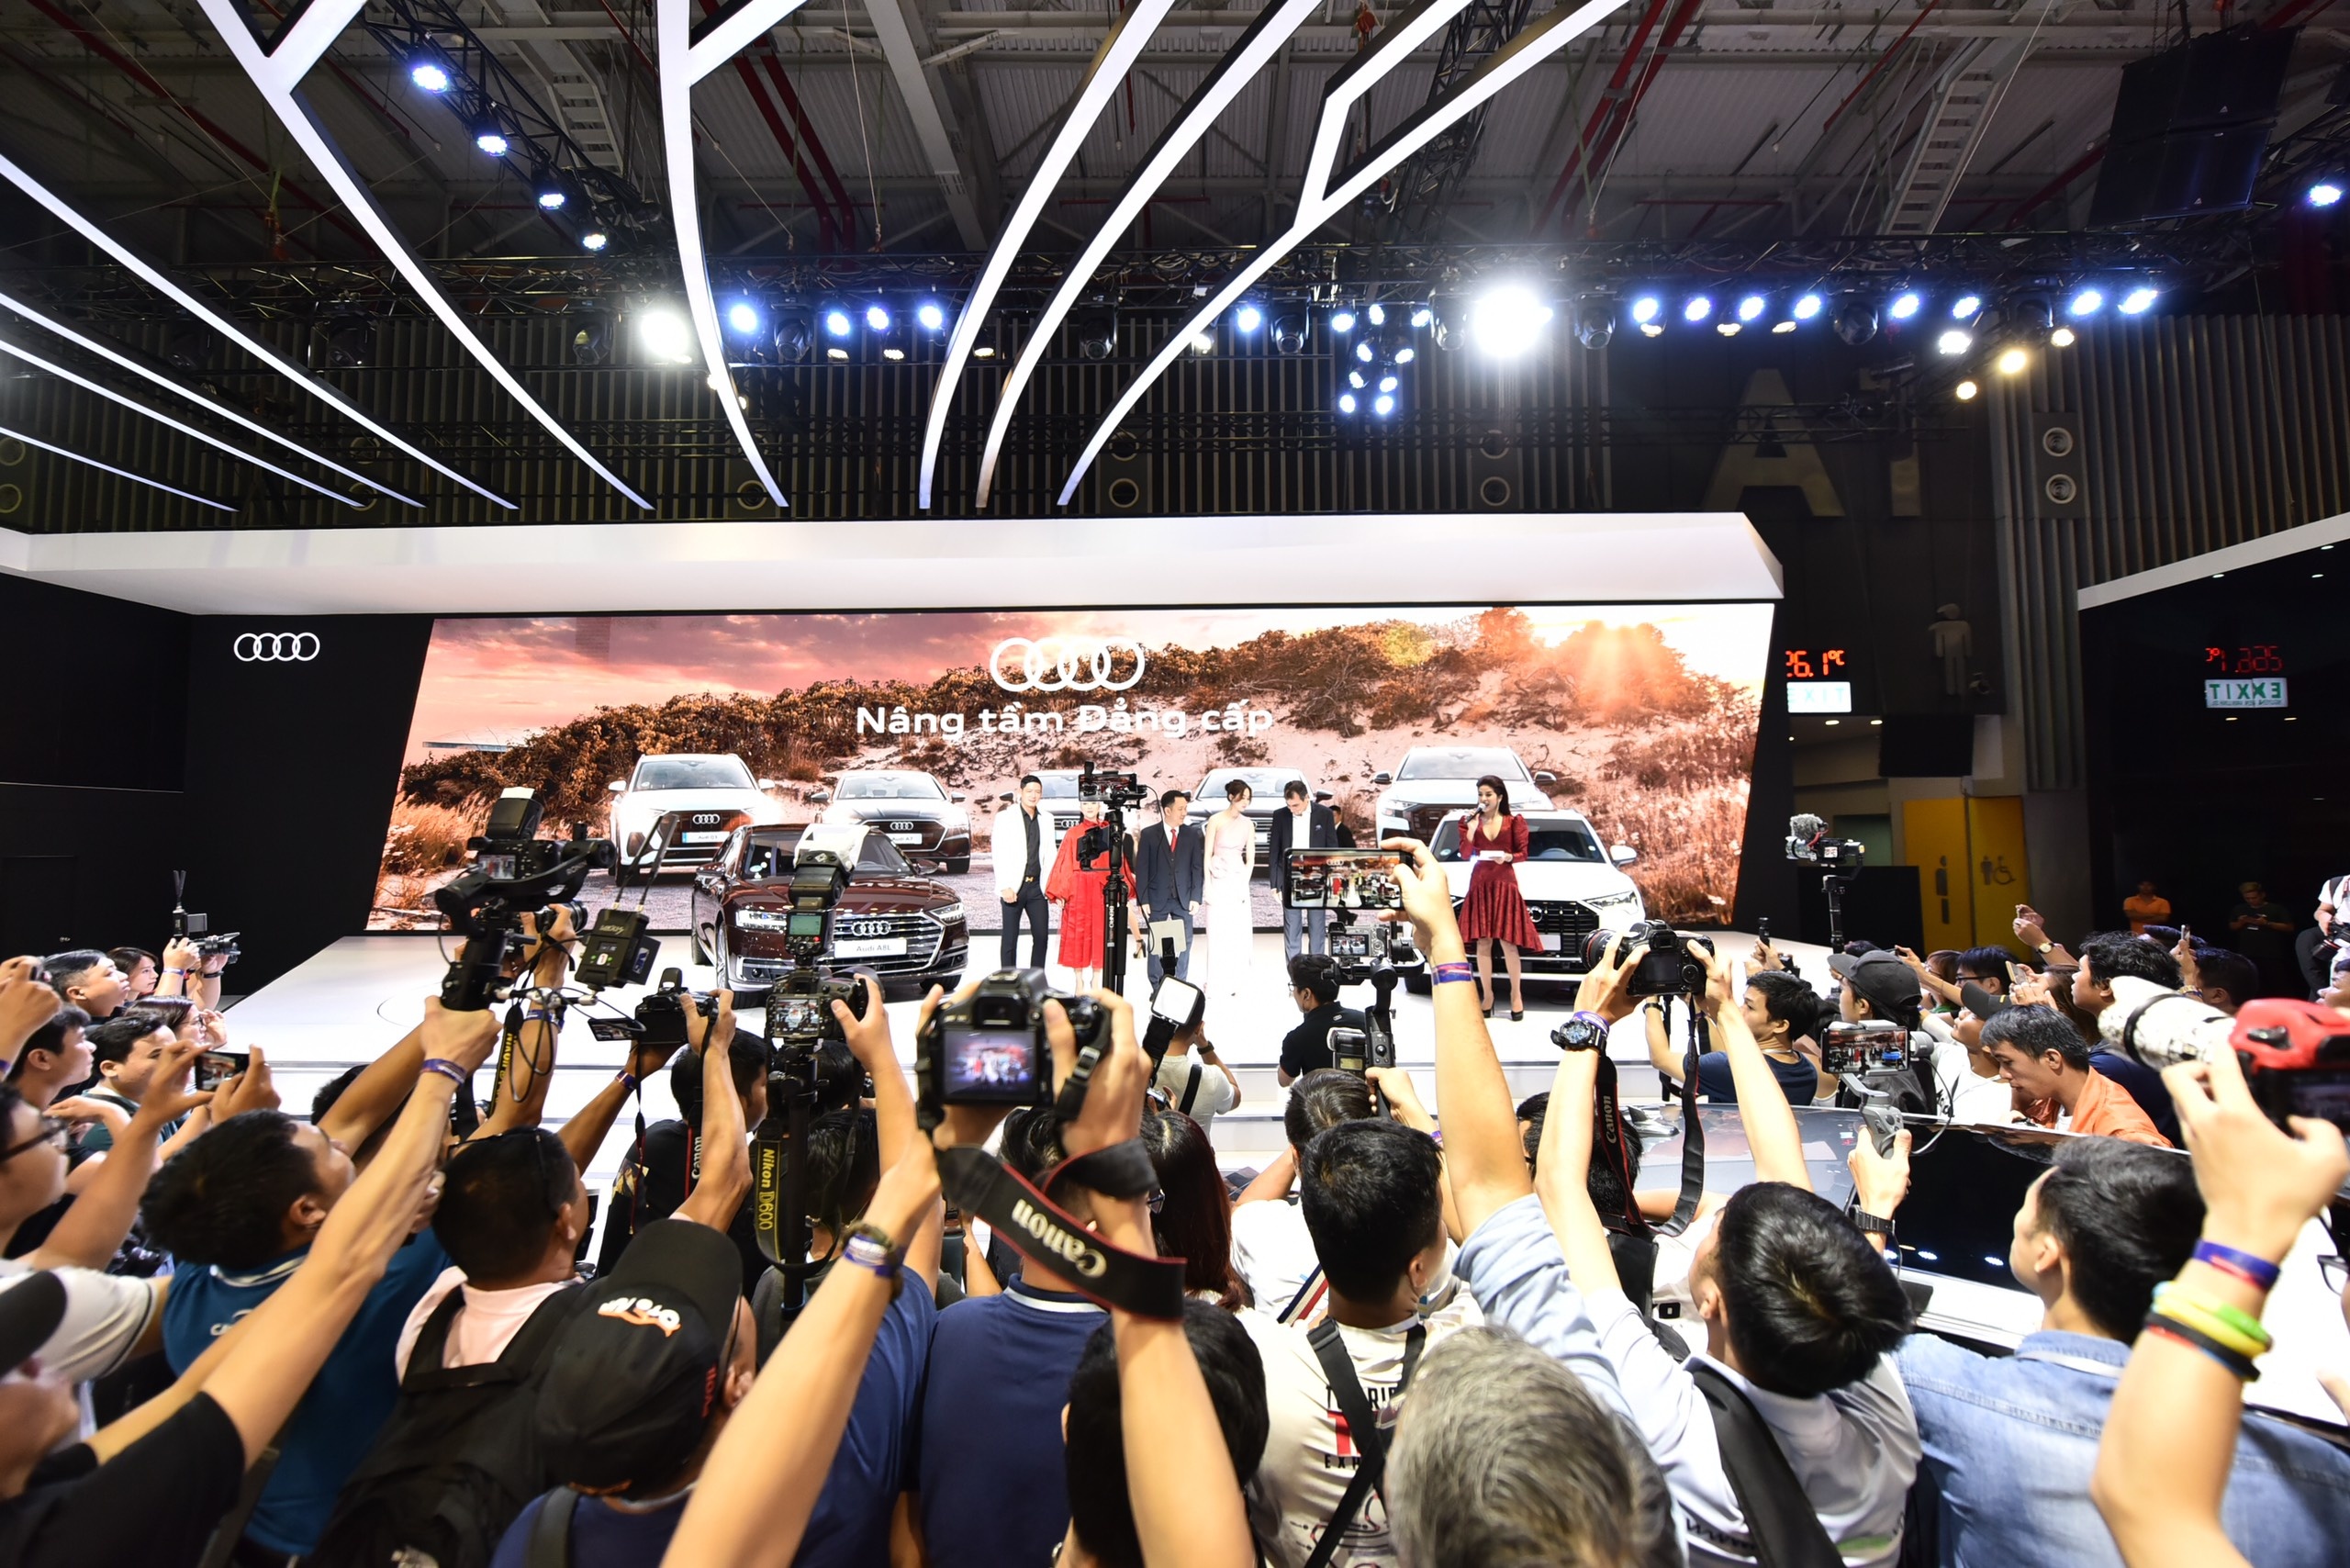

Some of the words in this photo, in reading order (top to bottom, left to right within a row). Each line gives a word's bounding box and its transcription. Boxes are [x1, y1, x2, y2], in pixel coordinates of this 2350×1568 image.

[856, 706, 965, 740] Nâng
[979, 701, 1064, 734] tầm
[1080, 697, 1186, 739] Đẳng
[1201, 699, 1273, 736] cấp
[856, 945, 875, 953] Audi
[877, 944, 892, 952] A8L
[1603, 1095, 1617, 1144] Canon
[691, 1137, 702, 1180] Canon
[761, 1148, 776, 1188] Nikon
[758, 1191, 776, 1231] D600
[1011, 1198, 1107, 1279] Canon
